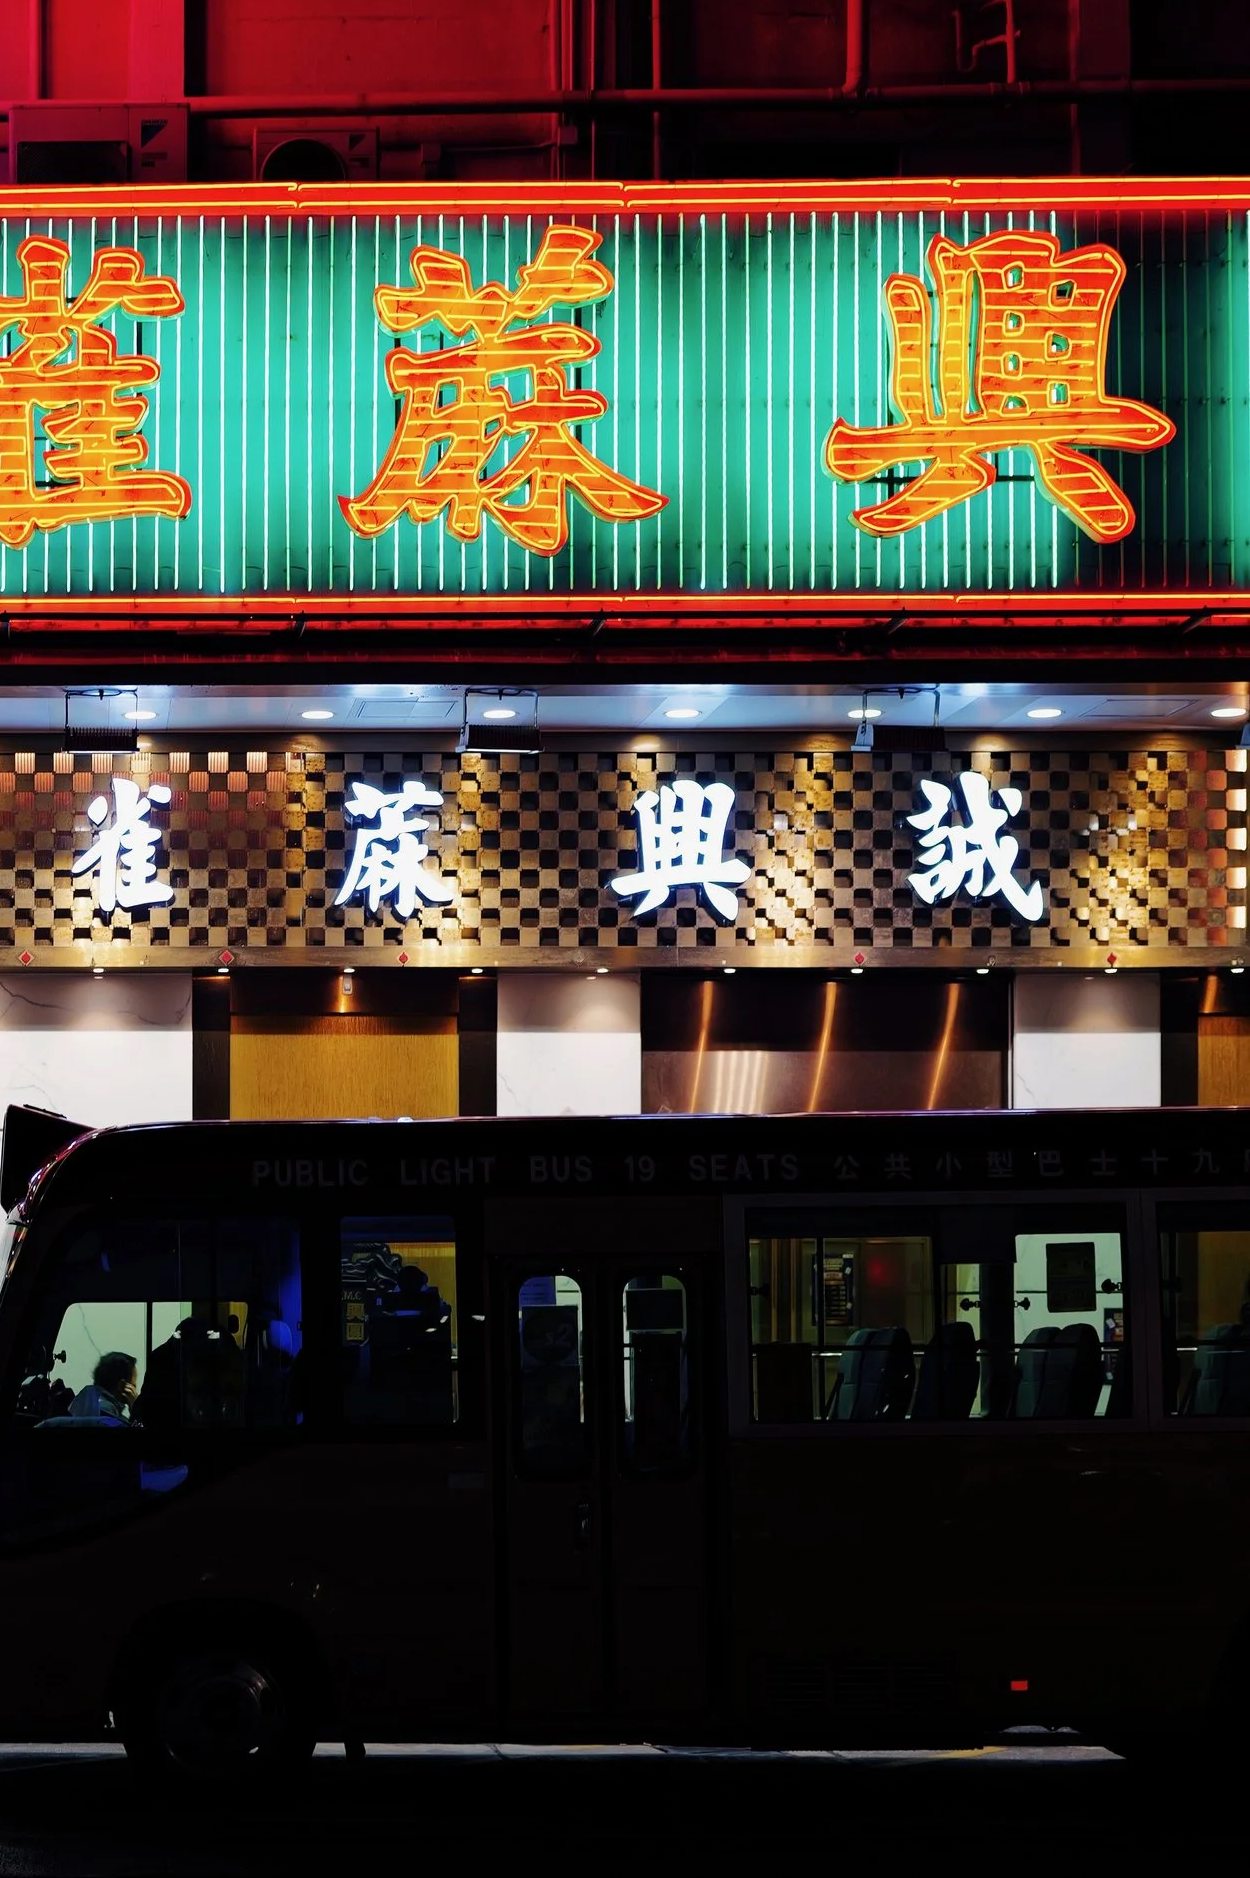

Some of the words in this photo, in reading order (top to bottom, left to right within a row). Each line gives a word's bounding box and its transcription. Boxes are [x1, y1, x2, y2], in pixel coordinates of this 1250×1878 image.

[251, 1158, 369, 1188] PUBLIC
[400, 1156, 497, 1186] LIGHT
[530, 1155, 594, 1184] BUS
[623, 1154, 658, 1182] 19
[688, 1152, 801, 1182] SEATS
